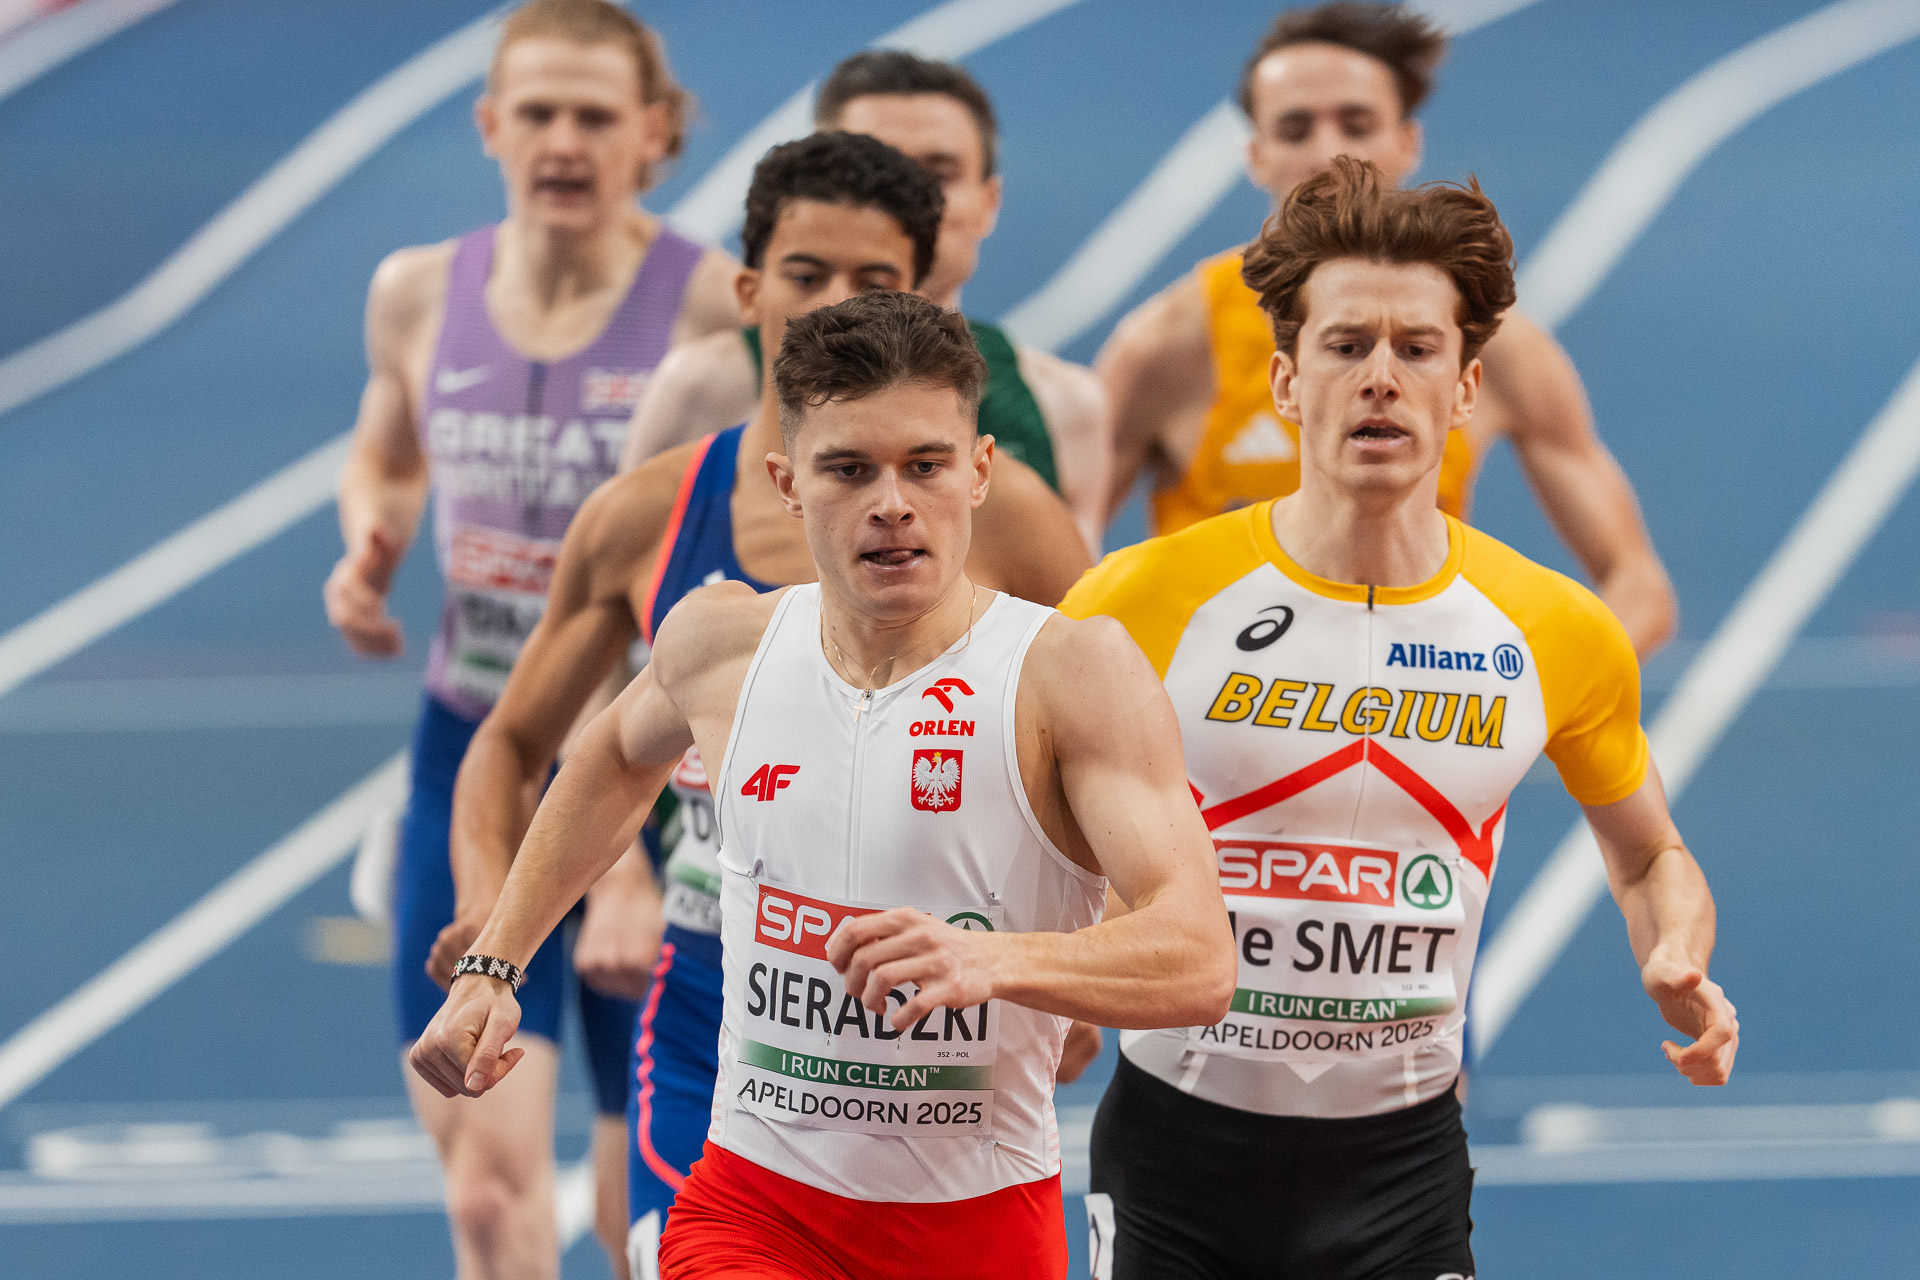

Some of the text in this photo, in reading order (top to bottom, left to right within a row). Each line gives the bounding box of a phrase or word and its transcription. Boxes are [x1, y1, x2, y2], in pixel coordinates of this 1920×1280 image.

[1386, 643, 1488, 672] Allianz
[909, 720, 975, 737] ORLEN
[1204, 671, 1507, 750] BELGIUM
[741, 763, 801, 802] 4F
[1217, 847, 1392, 900] SPAR
[1292, 919, 1456, 974] SMET
[747, 962, 989, 1042] SIERADZKI
[1249, 993, 1255, 1011] I
[1260, 993, 1313, 1018] RUN
[1200, 1018, 1437, 1050] APELDOORN 2025
[781, 1053, 787, 1071] I
[791, 1055, 839, 1081] RUN
[738, 1078, 983, 1125] APELDOORN 2025
